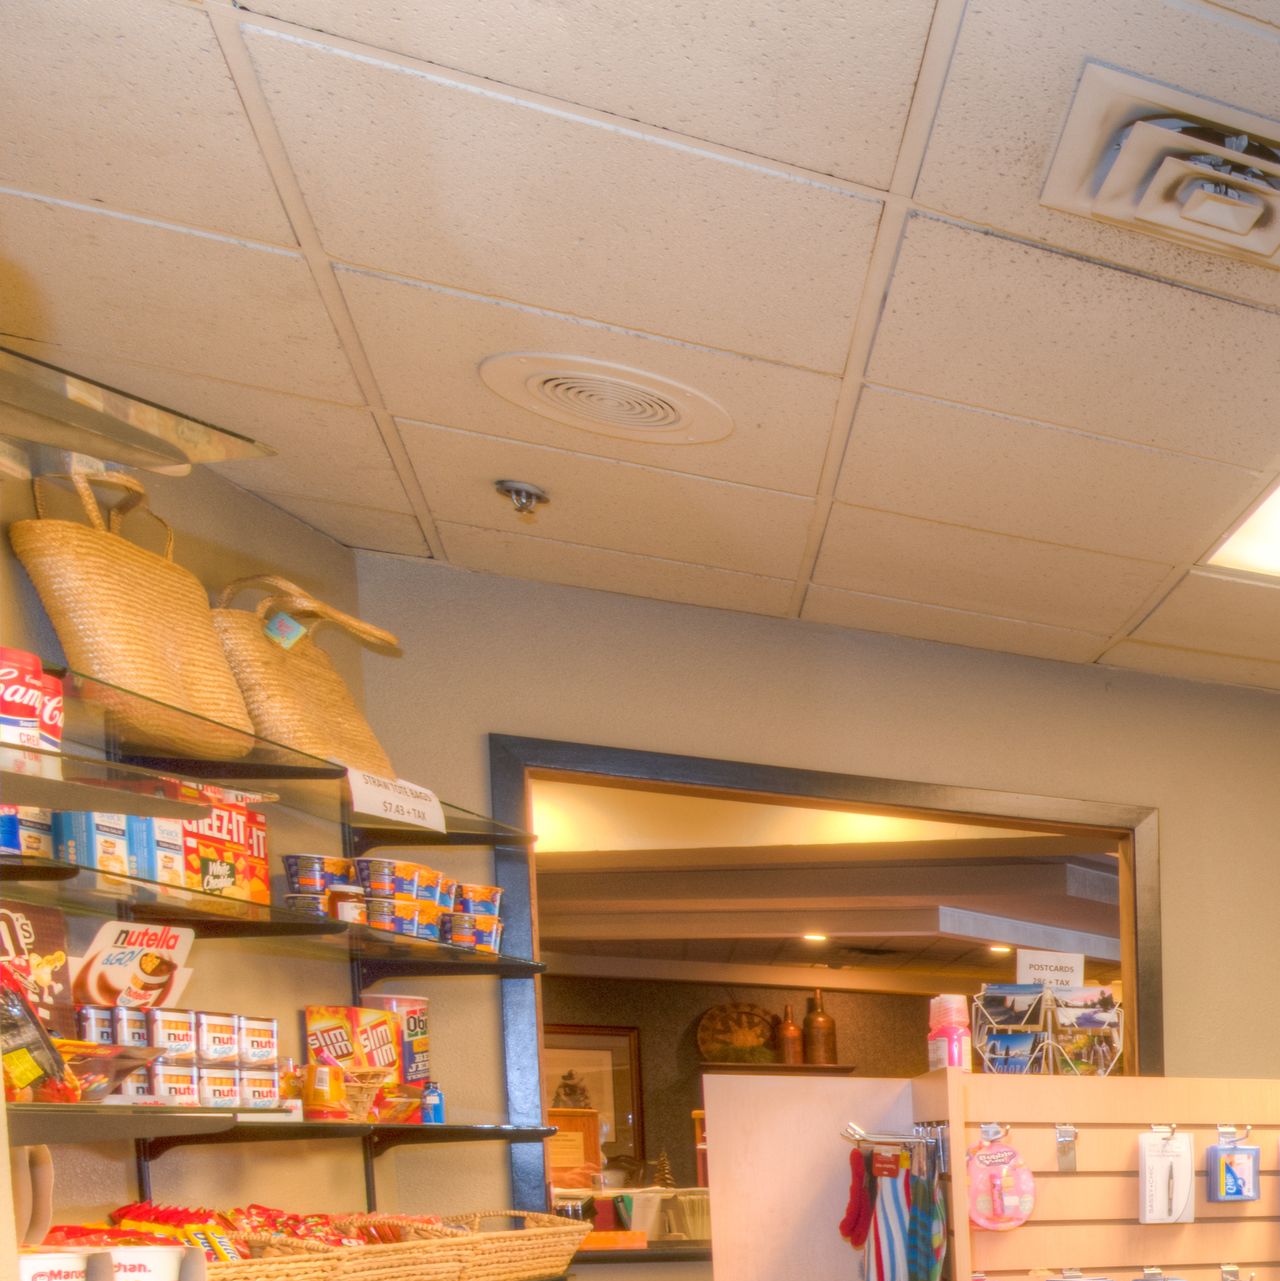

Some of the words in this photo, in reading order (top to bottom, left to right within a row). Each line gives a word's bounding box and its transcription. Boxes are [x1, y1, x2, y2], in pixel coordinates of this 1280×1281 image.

[362, 774, 387, 790] STRAW
[411, 808, 427, 821] TAX
[113, 926, 180, 950] nutella
[1029, 963, 1074, 973] POSTCARDS
